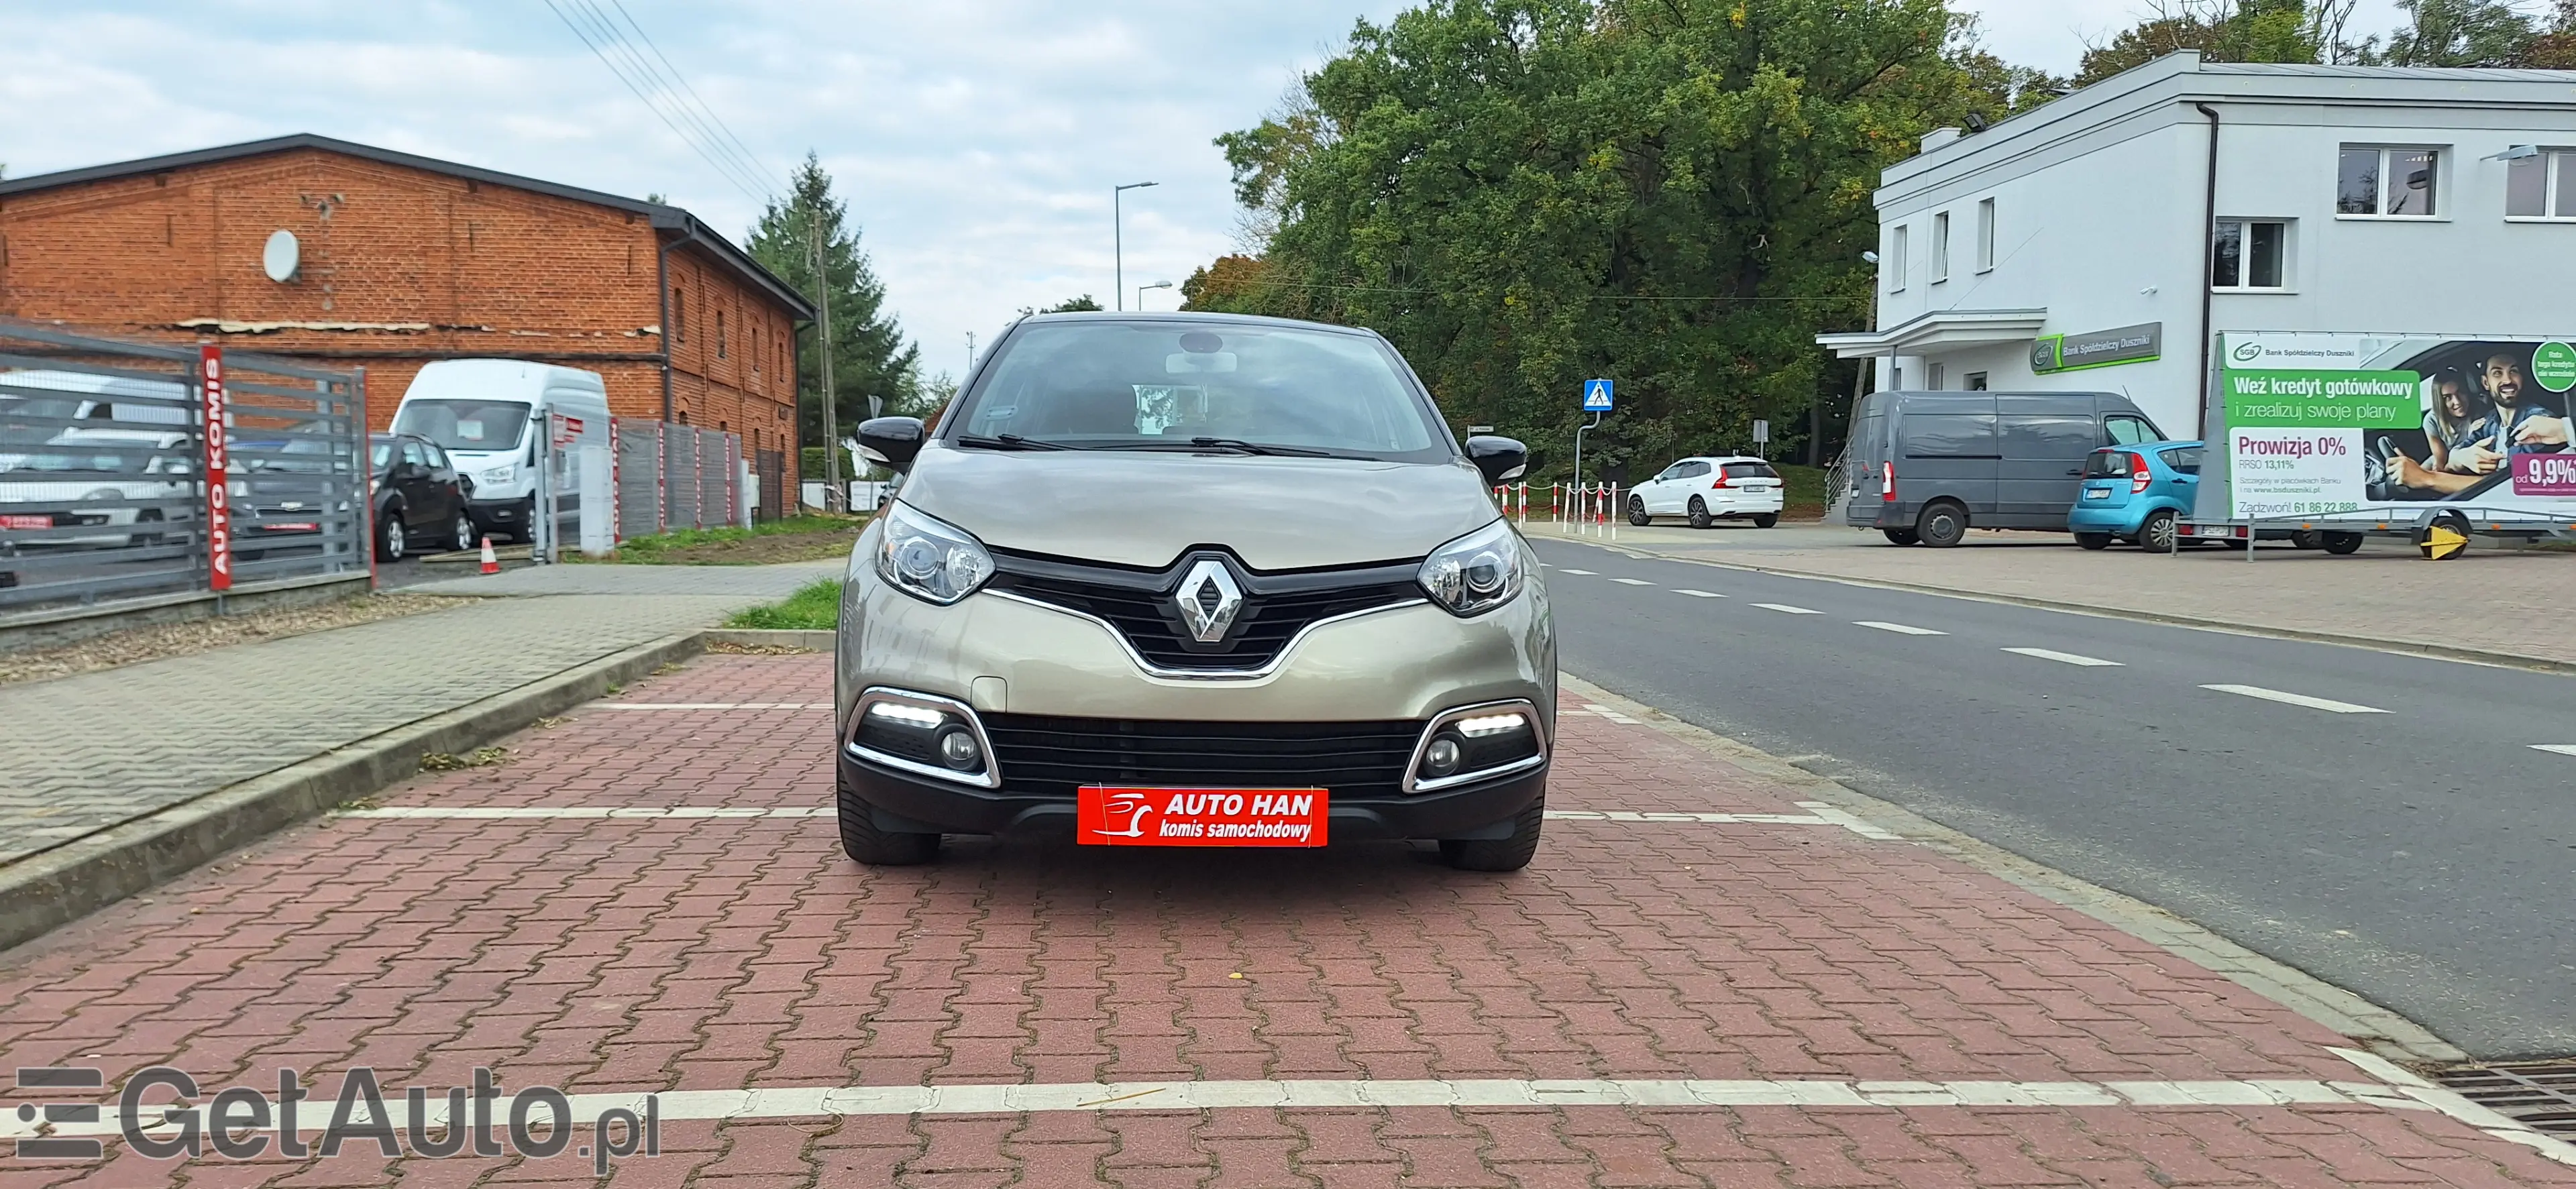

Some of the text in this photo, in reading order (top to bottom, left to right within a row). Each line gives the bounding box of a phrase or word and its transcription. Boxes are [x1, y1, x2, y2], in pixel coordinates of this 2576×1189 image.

[2063, 335, 2150, 356] Bank Spółdzielczy Duszniki
[2284, 349, 2325, 357] Spółdzielczy
[2234, 376, 2413, 400] Weź kredyt gotówkowy
[2235, 402, 2396, 421] i zrealizuj swoje plany
[2239, 437, 2346, 459] Prowizja 0%
[206, 357, 227, 575] AUTO KOMIS
[2239, 460, 2294, 470] RRSO 13,11%
[2240, 477, 2273, 486] Szczegóły
[2516, 475, 2528, 483] od
[2239, 502, 2357, 513] Zadzwoń! 61 86 22 888
[1165, 793, 1313, 816] AUTO HAN
[1159, 819, 1312, 842] komis samochodowy
